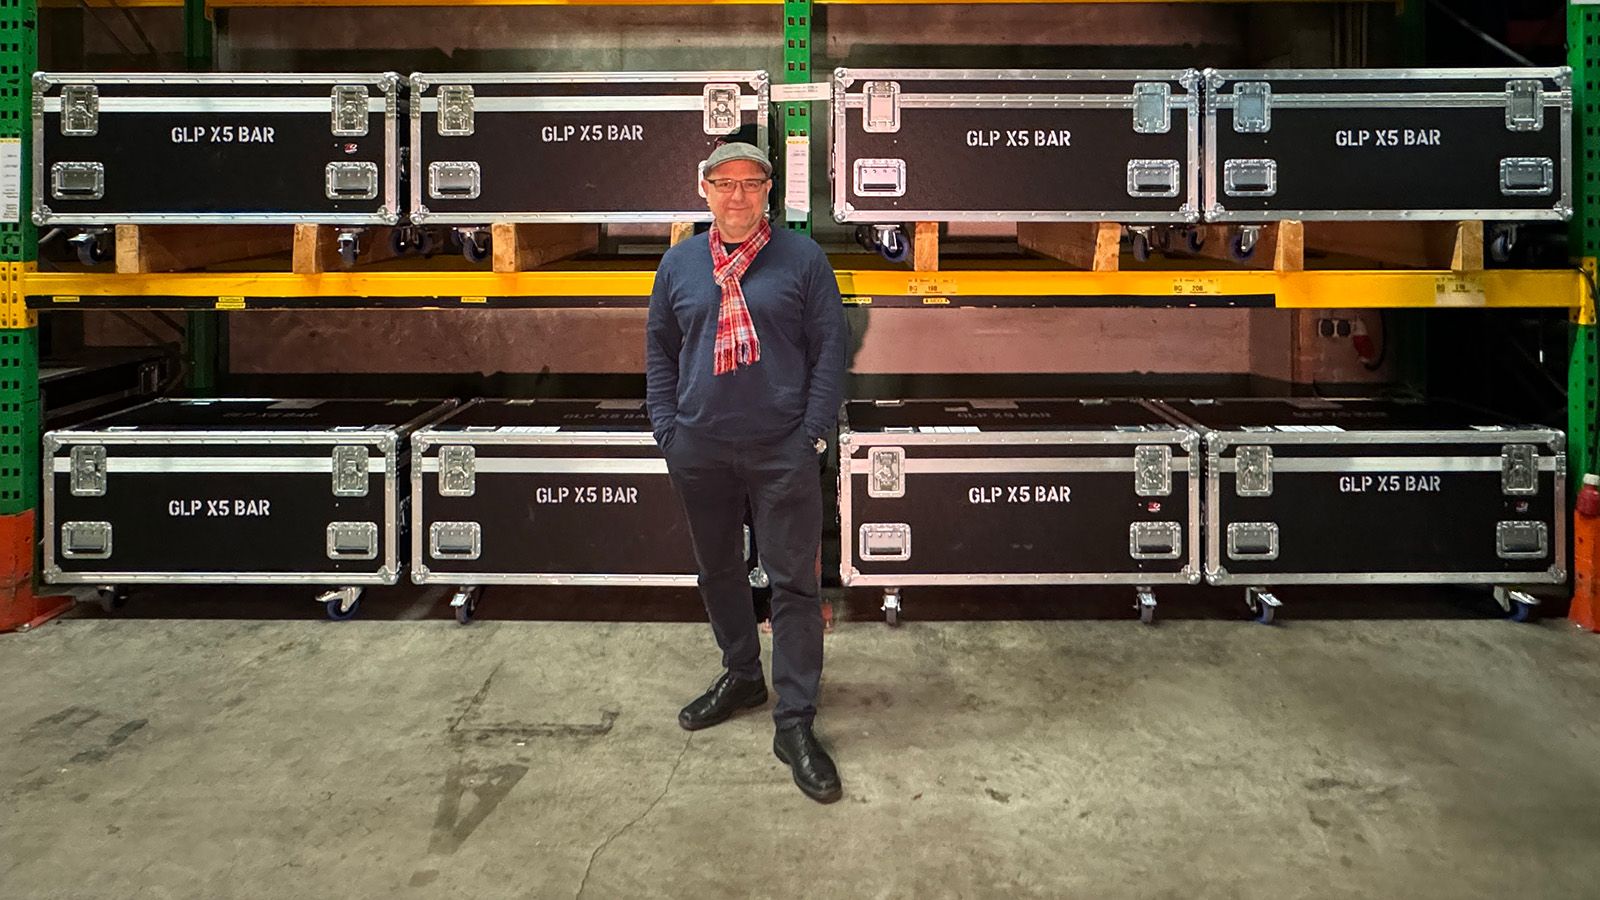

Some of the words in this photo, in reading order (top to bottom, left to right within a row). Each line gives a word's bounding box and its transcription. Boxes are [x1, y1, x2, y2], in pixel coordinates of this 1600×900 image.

[172, 127, 205, 142] GLP
[211, 127, 233, 142] X5
[239, 127, 274, 142] BAR
[542, 126, 574, 142] GLP
[580, 125, 602, 141] X5
[608, 125, 643, 140] BAR
[967, 130, 1000, 146] GLP
[1006, 130, 1029, 146] X5
[1035, 130, 1070, 146] BAR
[1336, 130, 1369, 146] GLP
[1376, 130, 1398, 146] X5
[1404, 129, 1440, 145] BAR
[1340, 476, 1372, 492] GLP
[1378, 476, 1400, 492] X5
[1406, 476, 1440, 491] BAR
[536, 487, 569, 503] GLP
[575, 487, 597, 503] X5
[602, 487, 637, 503] BAR
[969, 487, 1002, 503] GLP
[1008, 487, 1030, 503] X5
[1035, 486, 1070, 502] BAR
[169, 500, 202, 516] GLP
[208, 500, 229, 516] X5
[235, 500, 270, 516] BAR
